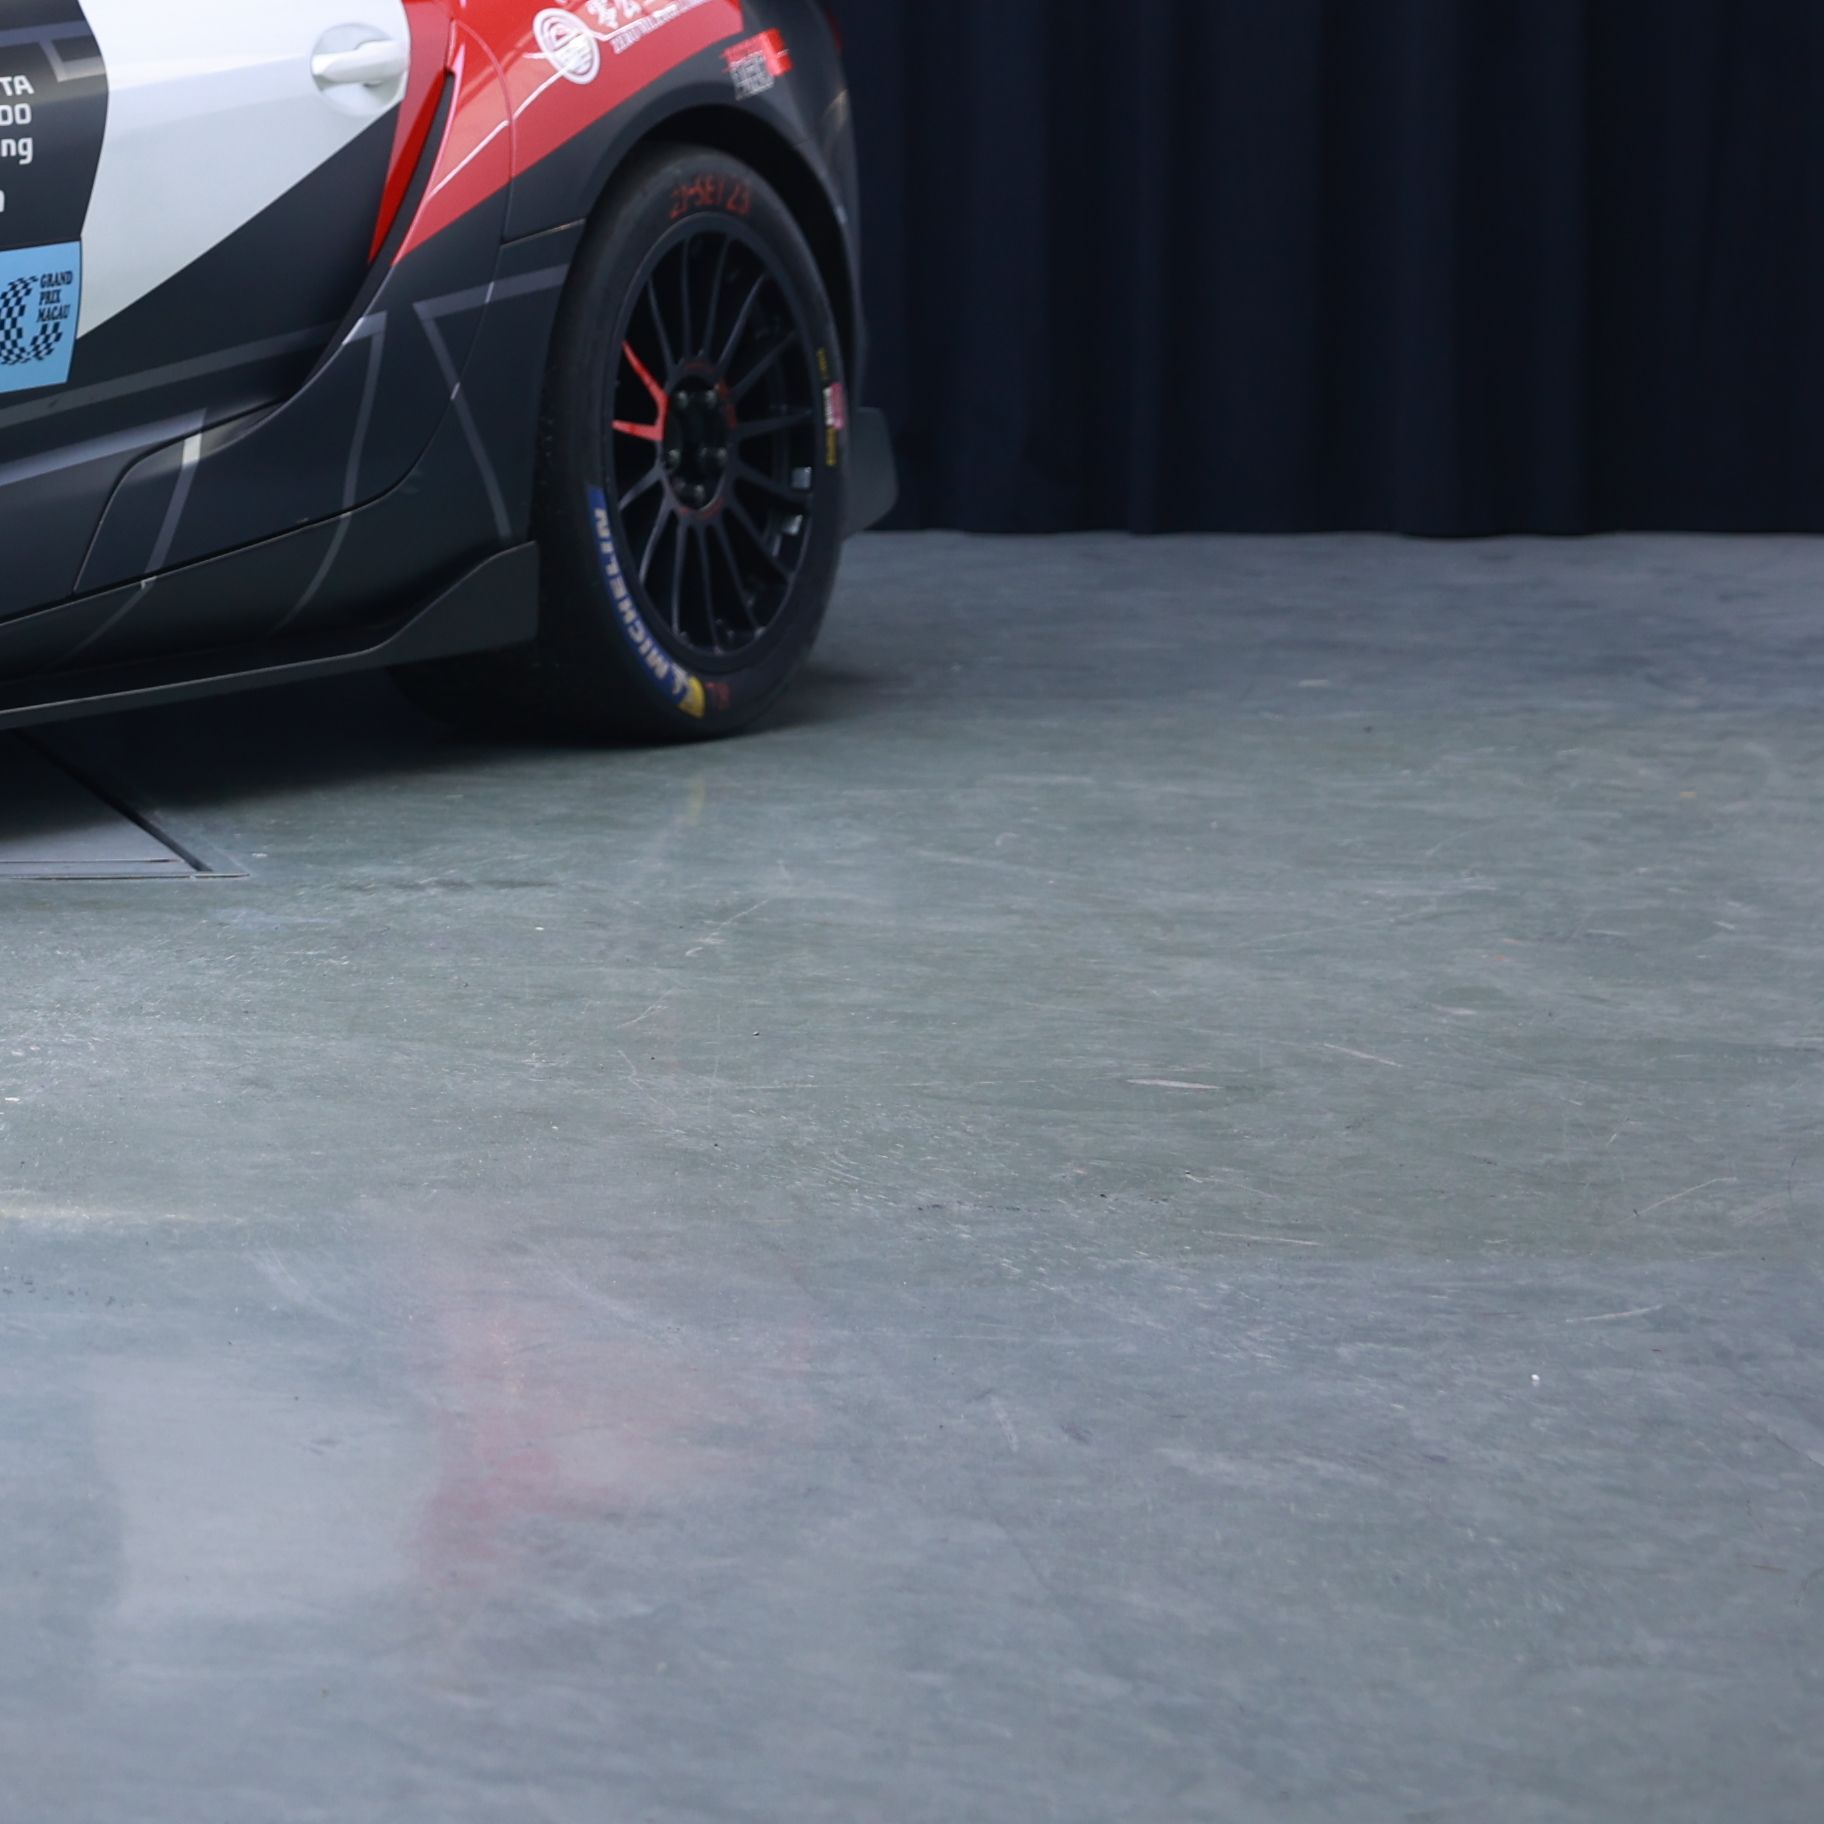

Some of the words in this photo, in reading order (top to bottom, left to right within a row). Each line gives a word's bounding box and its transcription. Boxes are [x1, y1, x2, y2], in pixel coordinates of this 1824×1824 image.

[40, 270, 73, 288] GRAND
[37, 304, 71, 323] MACAU
[593, 507, 670, 681] MICHELIN
